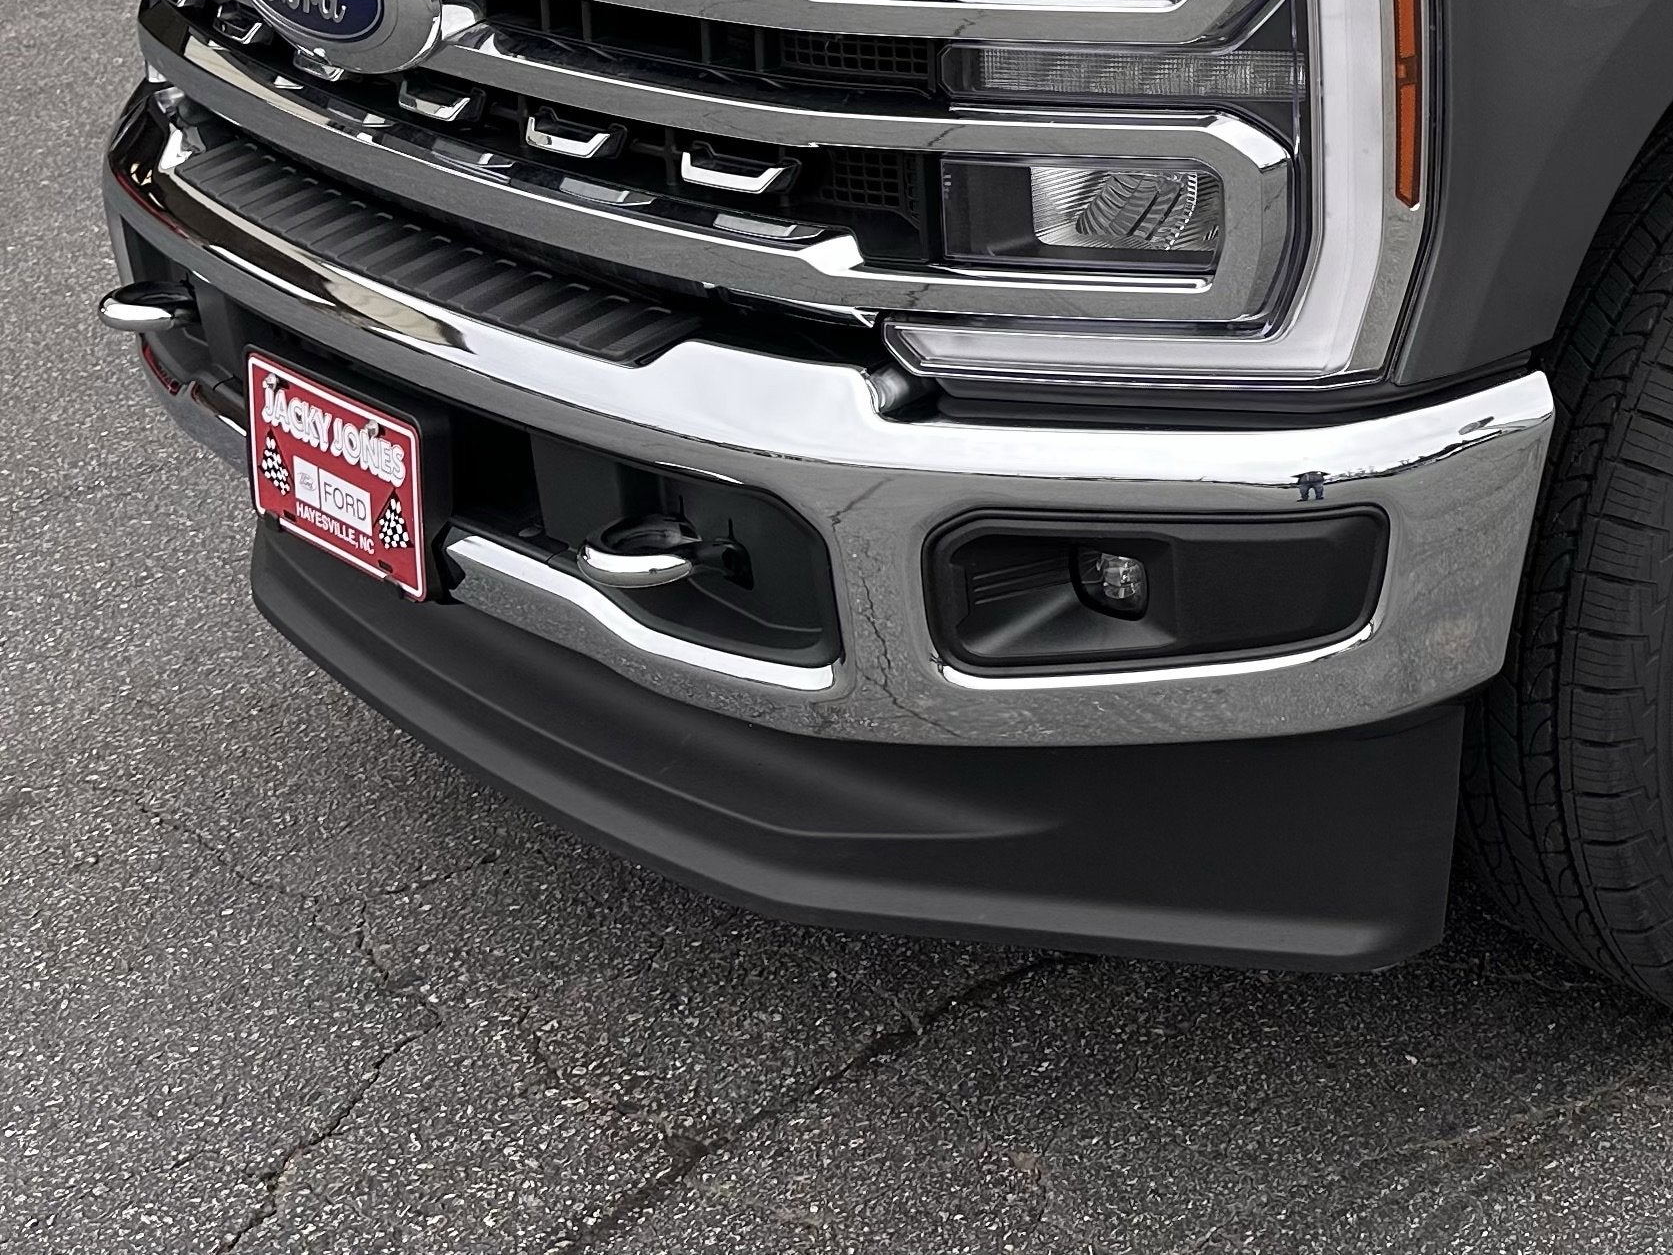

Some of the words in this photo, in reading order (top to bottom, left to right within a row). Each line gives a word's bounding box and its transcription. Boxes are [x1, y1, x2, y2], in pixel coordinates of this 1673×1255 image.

[261, 384, 333, 453] JACKY
[331, 417, 407, 488] JONES
[295, 501, 359, 549] HAYESVILLE,
[359, 534, 375, 555] NC
[323, 481, 367, 521] FORD
